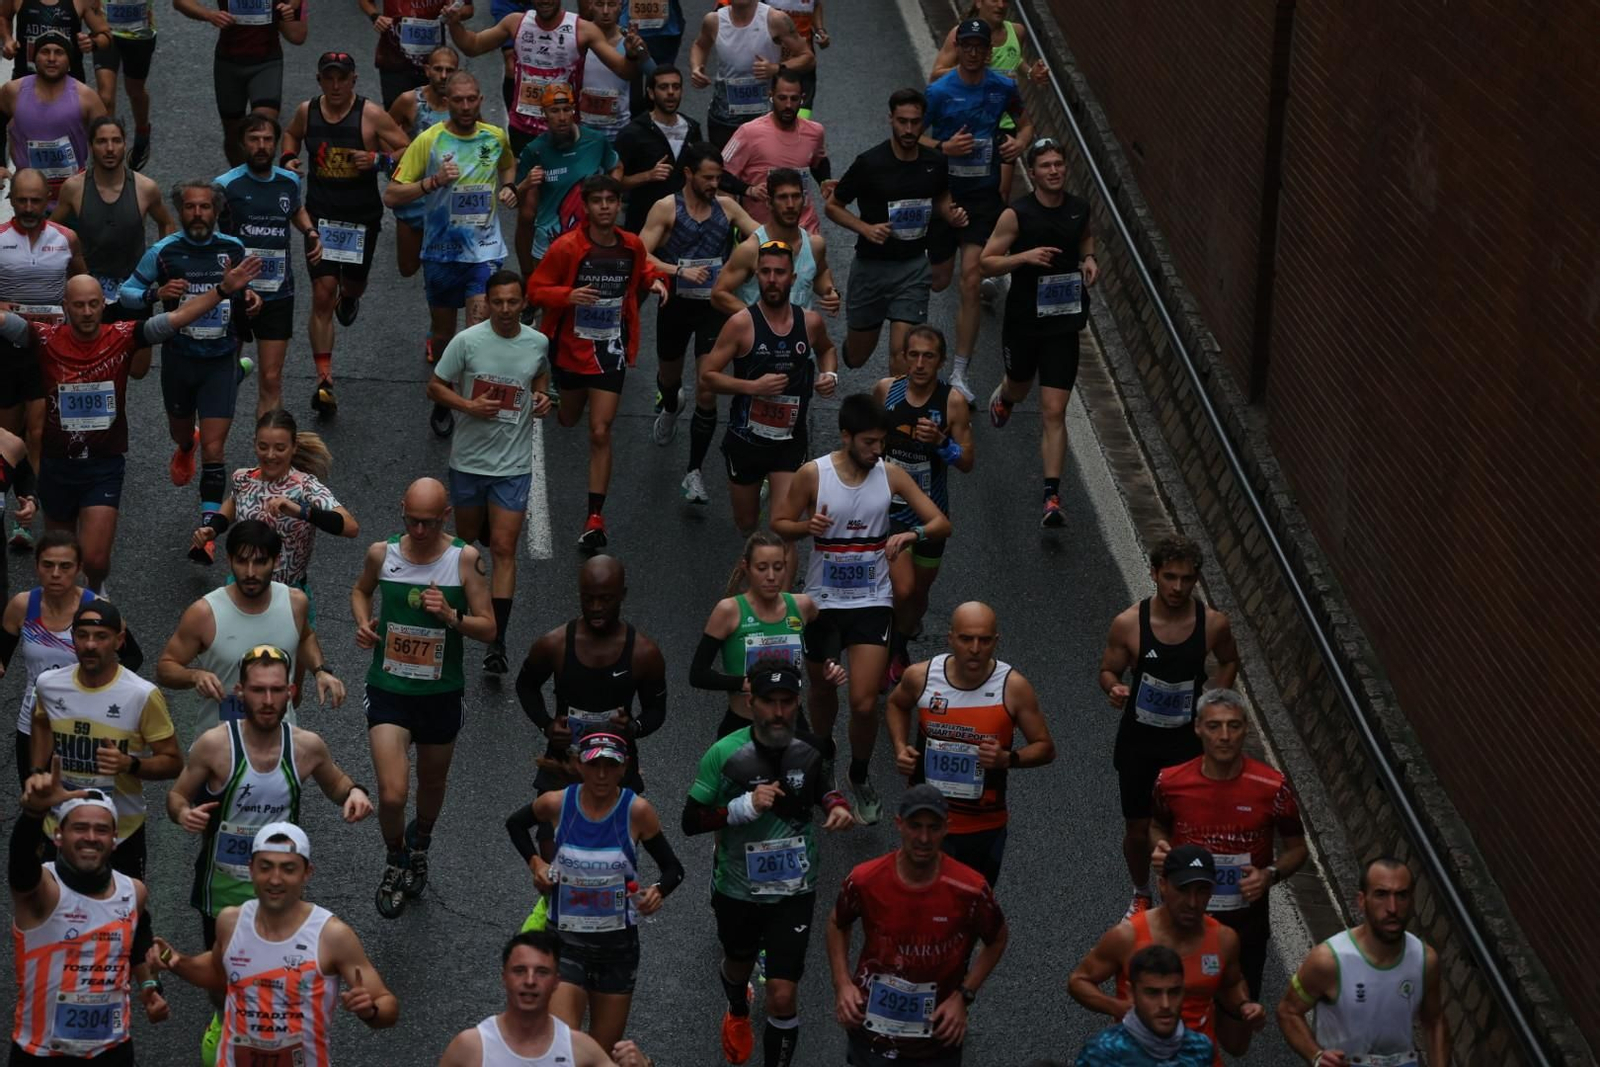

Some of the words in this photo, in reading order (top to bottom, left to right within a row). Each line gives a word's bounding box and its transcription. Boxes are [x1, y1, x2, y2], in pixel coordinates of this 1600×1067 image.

[634, 3, 659, 14] 5303
[36, 150, 64, 163] 1730
[458, 194, 485, 208] 2431
[325, 230, 353, 245] 2597
[68, 395, 102, 410] 3198
[829, 565, 864, 580] 2539
[394, 637, 430, 656] 5677
[74, 721, 91, 735] 59
[932, 756, 970, 774] 1850
[263, 805, 285, 814] Park
[757, 853, 796, 873] 2678
[80, 978, 115, 986] TEAM
[878, 989, 919, 1013] 2925
[65, 1008, 110, 1029] 2304
[250, 1024, 288, 1033] TEAM
